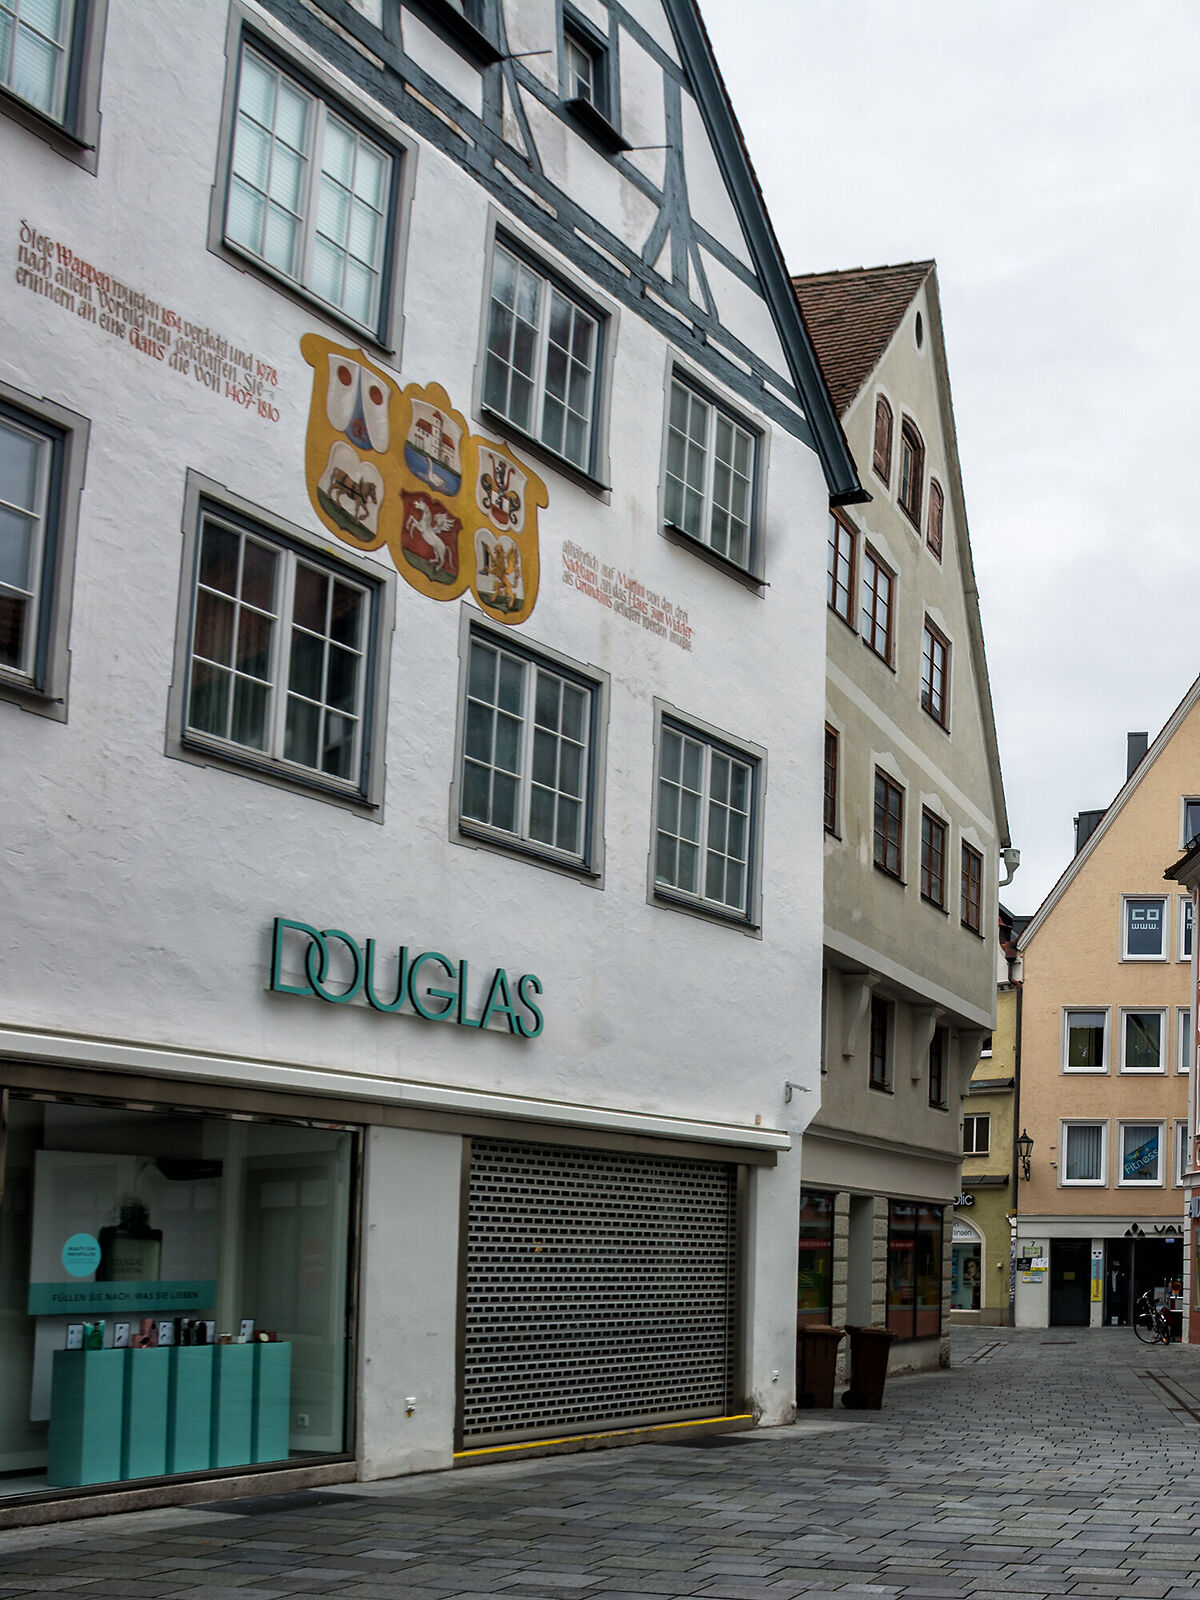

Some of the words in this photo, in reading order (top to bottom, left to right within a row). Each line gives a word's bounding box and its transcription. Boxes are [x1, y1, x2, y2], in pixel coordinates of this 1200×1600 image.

[16, 264, 75, 313] erinnern
[77, 300, 97, 324] an
[99, 312, 127, 338] eine
[168, 350, 190, 375] die
[194, 363, 221, 394] von
[18, 244, 52, 282] nach
[54, 265, 92, 302] altem
[147, 319, 171, 346] neu
[57, 241, 110, 291] Wappen
[229, 345, 253, 372] und
[269, 917, 544, 1039] DOUGLAS
[52, 1292, 87, 1303] FÜLLEN
[88, 1292, 103, 1302] SIE
[135, 1291, 154, 1300] WAS
[156, 1290, 170, 1300] SIE
[170, 1290, 199, 1300] LIEBEN
